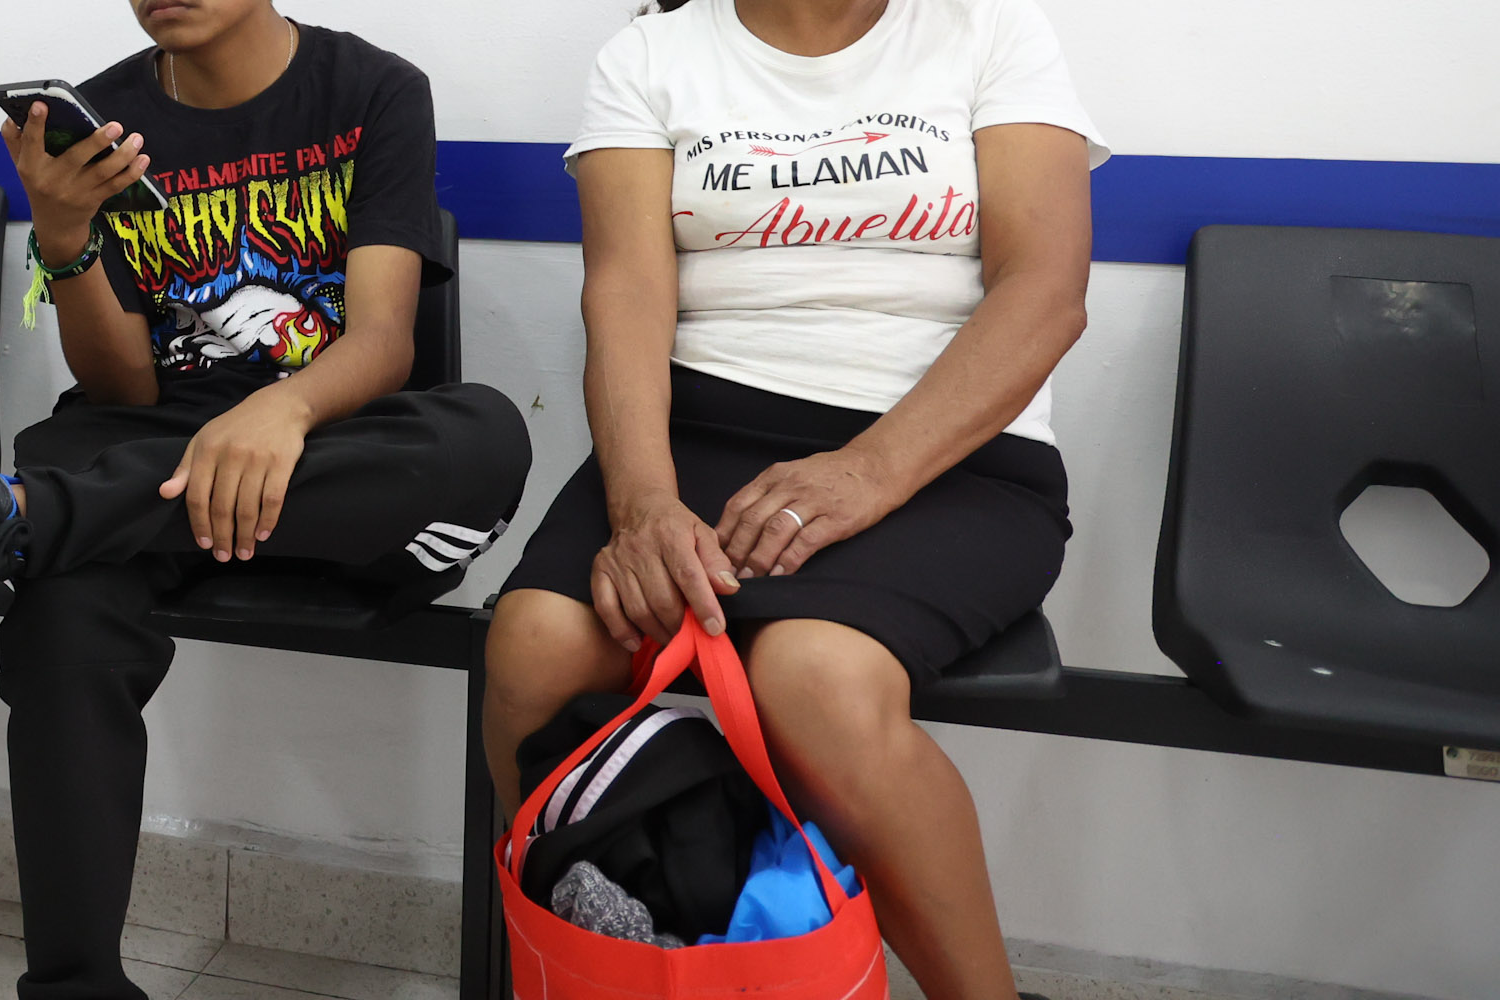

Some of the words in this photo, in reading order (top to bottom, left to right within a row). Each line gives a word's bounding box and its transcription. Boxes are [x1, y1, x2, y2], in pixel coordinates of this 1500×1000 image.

[686, 136, 713, 162] MIS
[720, 129, 833, 144] PERSONAS
[841, 113, 950, 142] VORITAS
[702, 162, 754, 191] ME
[771, 146, 929, 189] LLAMAN
[714, 185, 978, 249] Abuelita
